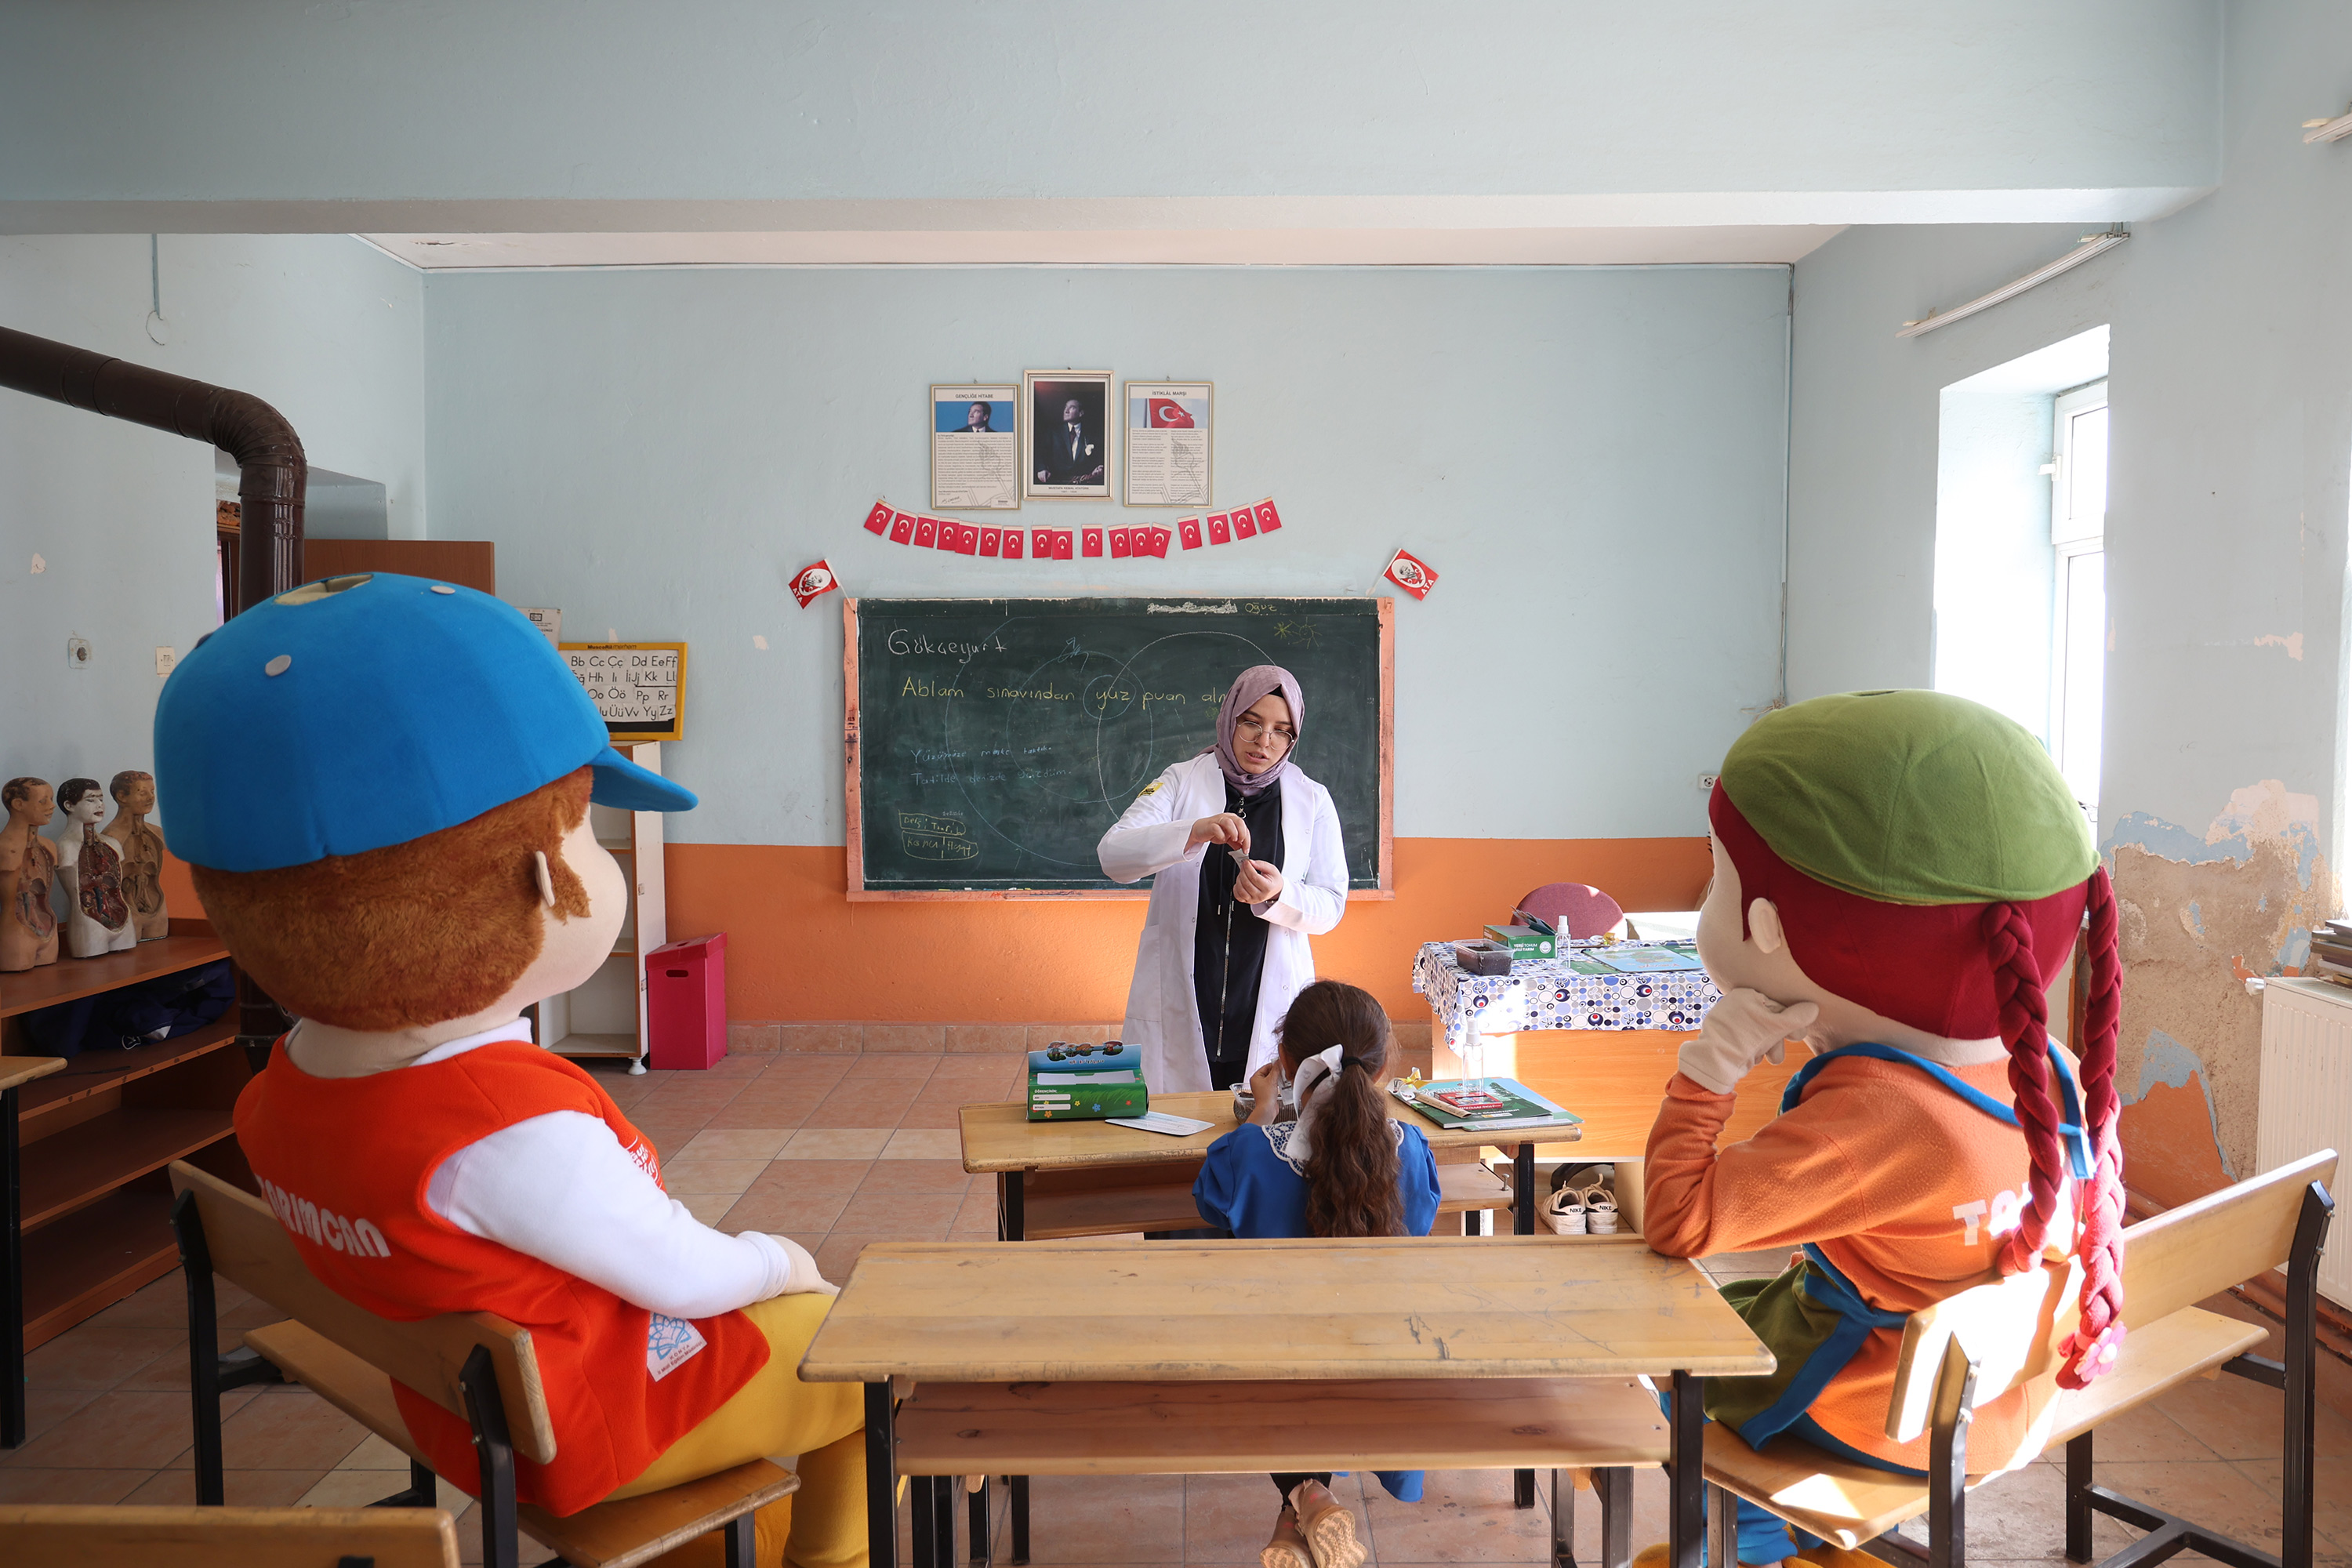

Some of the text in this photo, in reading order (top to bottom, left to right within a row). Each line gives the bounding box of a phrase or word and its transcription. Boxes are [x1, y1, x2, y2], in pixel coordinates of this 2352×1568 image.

[1421, 579, 1435, 595] ATA
[1244, 601, 1277, 614] Oğuz
[571, 655, 677, 668] Bb Cc Çç Dd Ee Ff
[589, 672, 604, 682] Hh
[644, 670, 658, 682] Kk
[608, 686, 626, 699] Öö
[636, 690, 649, 705] Pp
[658, 691, 670, 701] Rr
[902, 677, 964, 698] Ablam
[1142, 691, 1186, 710] puan
[609, 704, 623, 717] Üü
[644, 706, 657, 720] Yy
[659, 705, 673, 717] Zz
